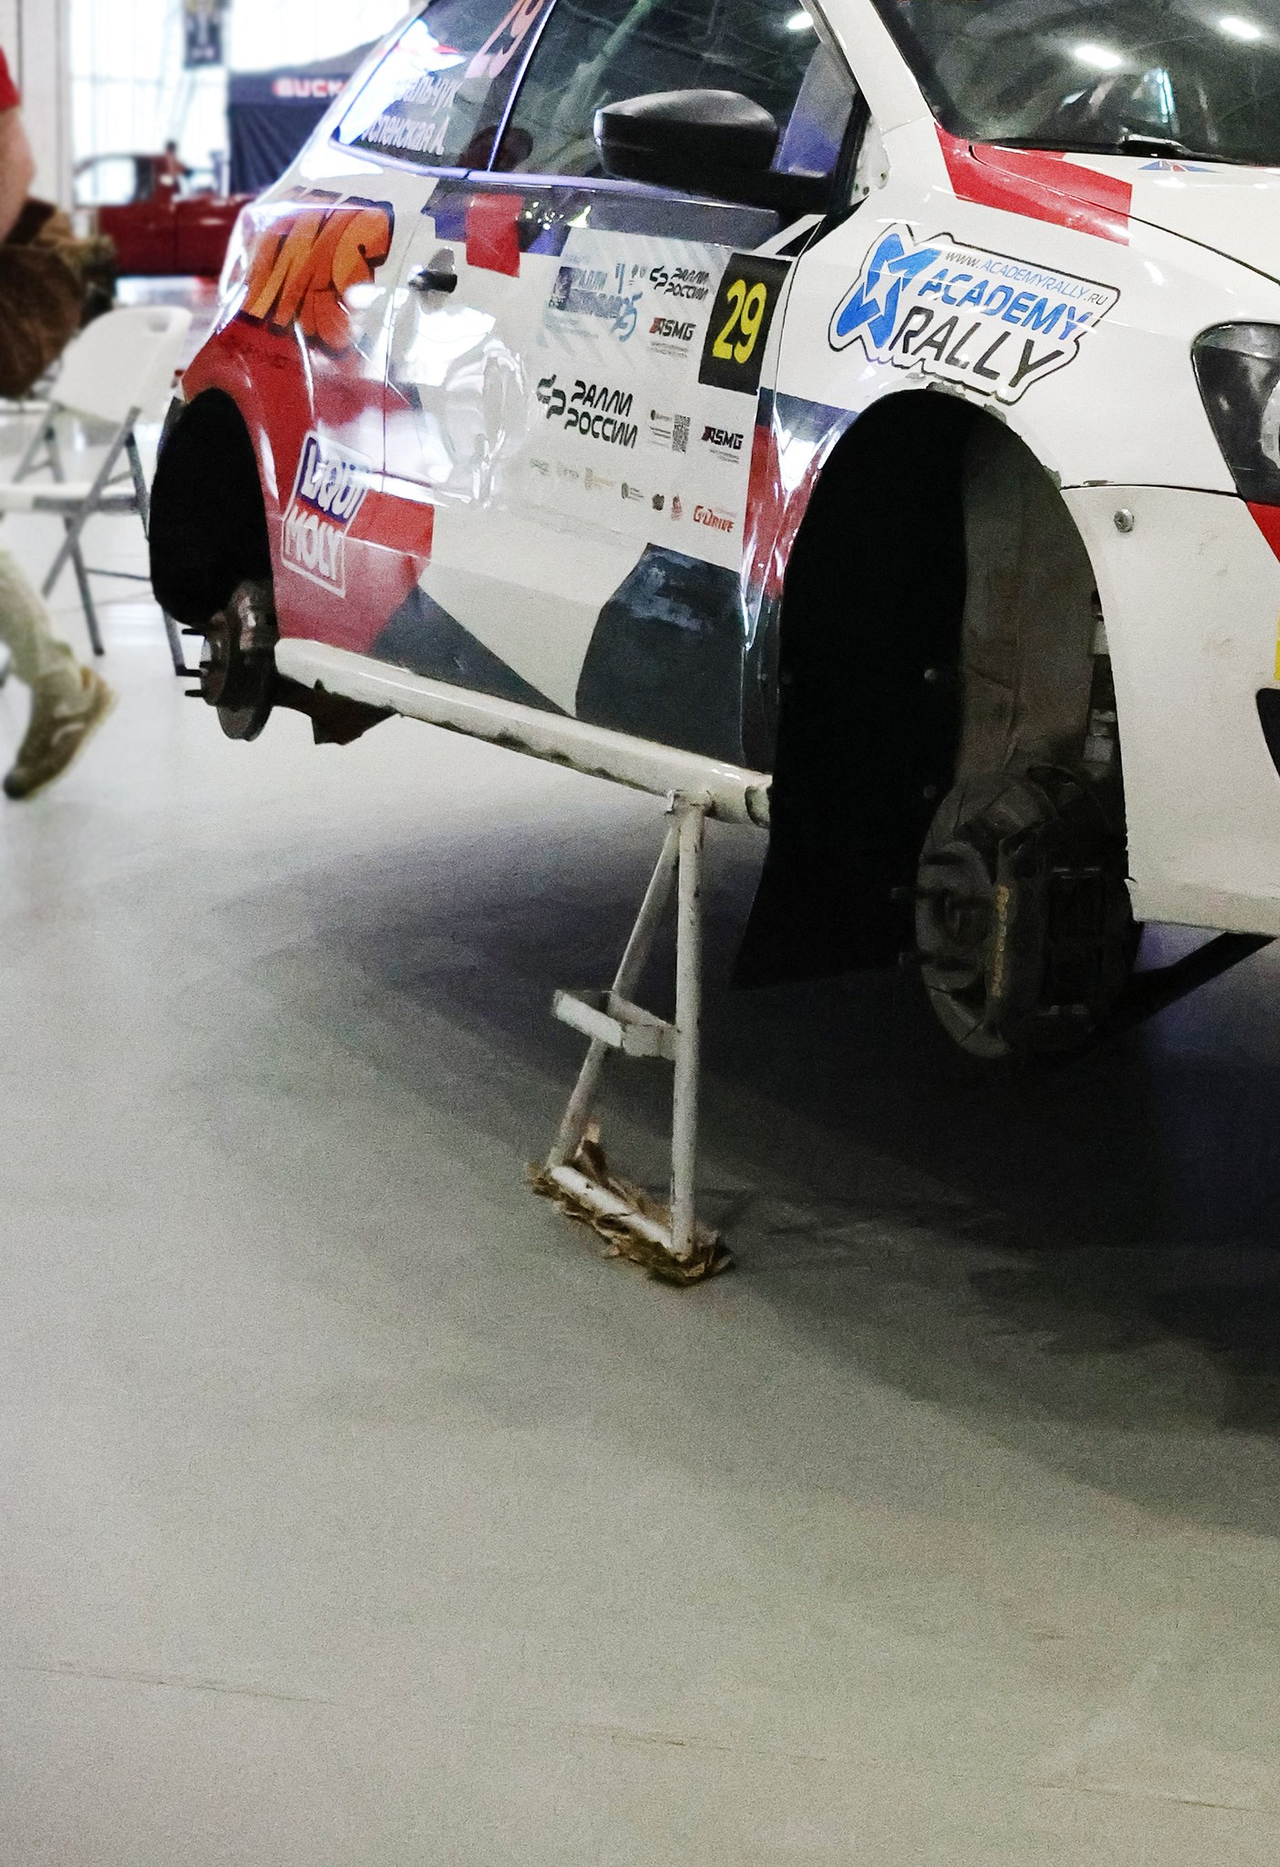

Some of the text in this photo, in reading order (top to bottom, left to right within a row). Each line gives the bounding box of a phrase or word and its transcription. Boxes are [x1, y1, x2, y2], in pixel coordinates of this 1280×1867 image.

[712, 279, 767, 364] 29
[917, 268, 1094, 341] ACADEMY
[888, 305, 1065, 388] RALLY
[564, 407, 639, 449] РОССИИ
[570, 380, 634, 418] РАЛЛИ
[701, 425, 744, 450] ASMG
[284, 504, 345, 581] MOLY
